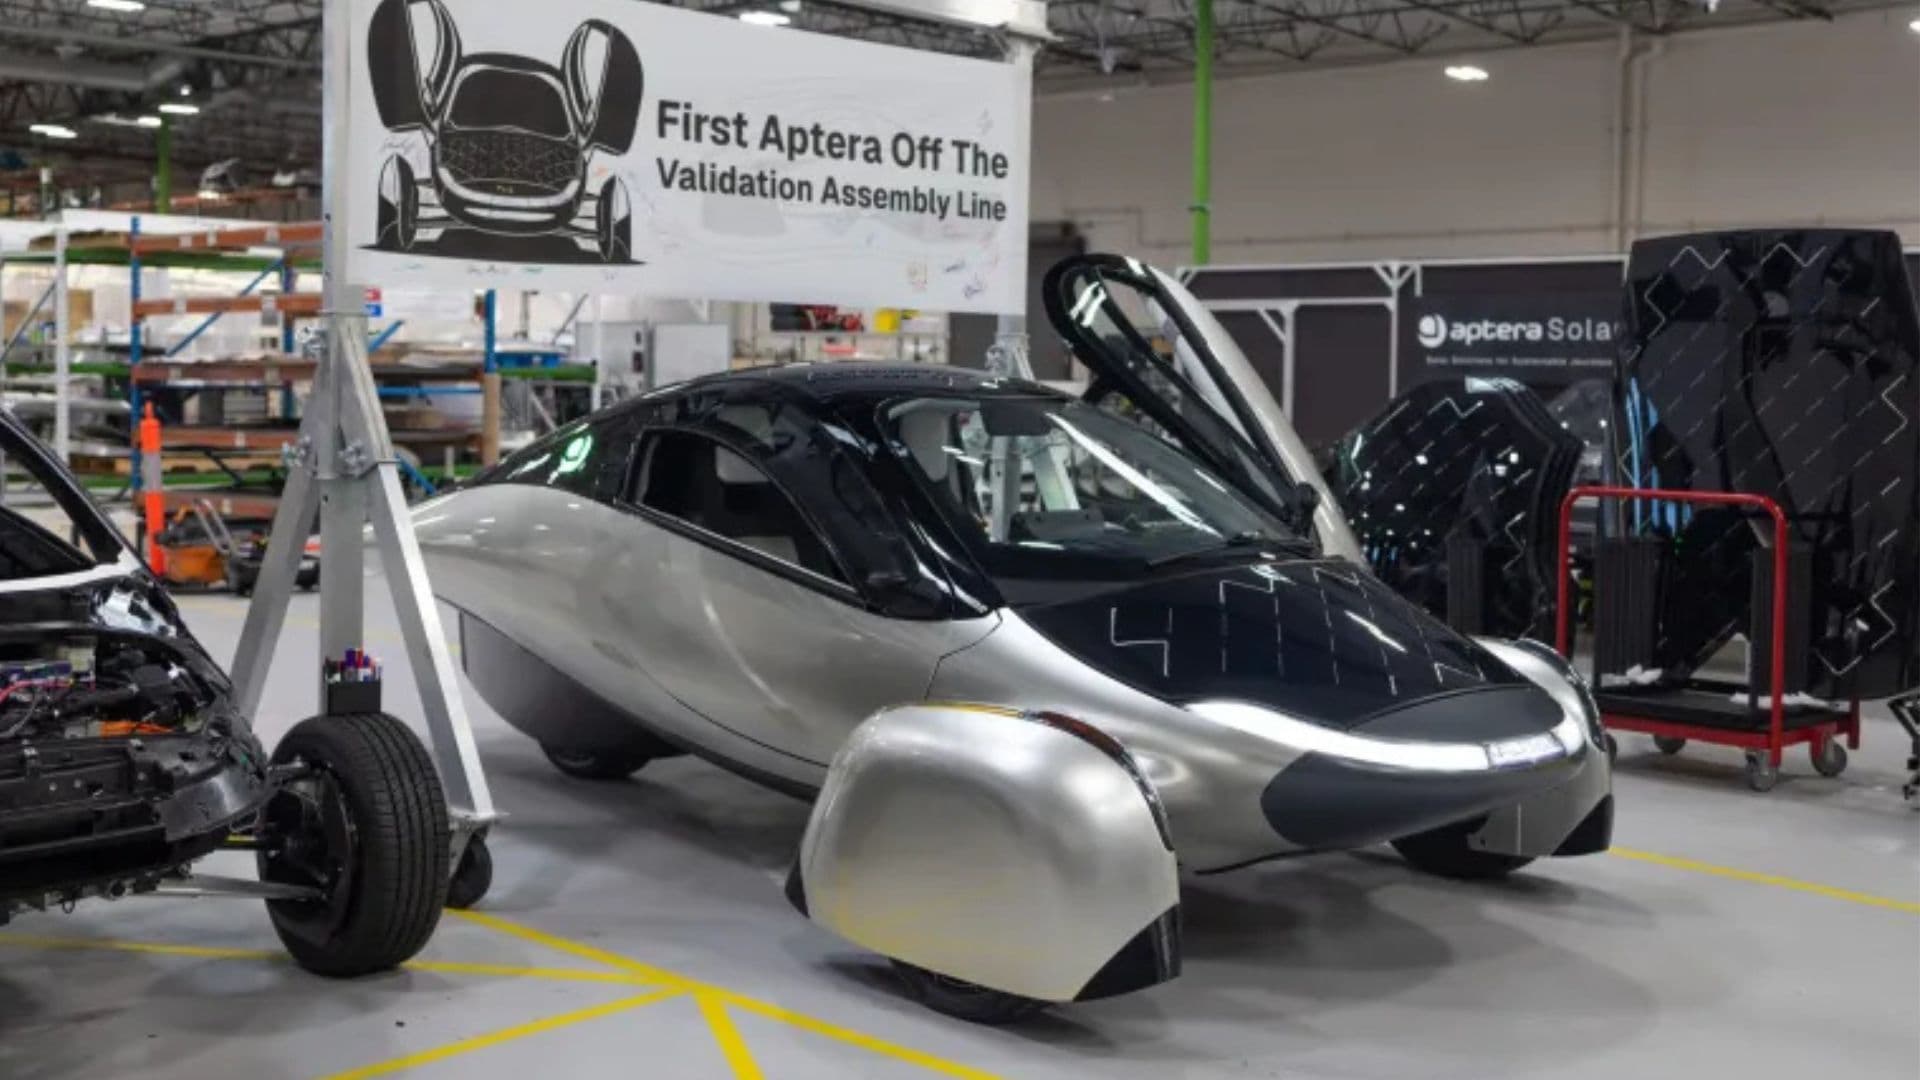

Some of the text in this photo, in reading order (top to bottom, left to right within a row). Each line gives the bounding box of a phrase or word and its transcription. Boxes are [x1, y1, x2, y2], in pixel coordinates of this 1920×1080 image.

[657, 99, 1008, 178] First Aptera Off The
[656, 157, 1007, 221] Validation Assembly Line
[1450, 319, 1543, 345] aptera
